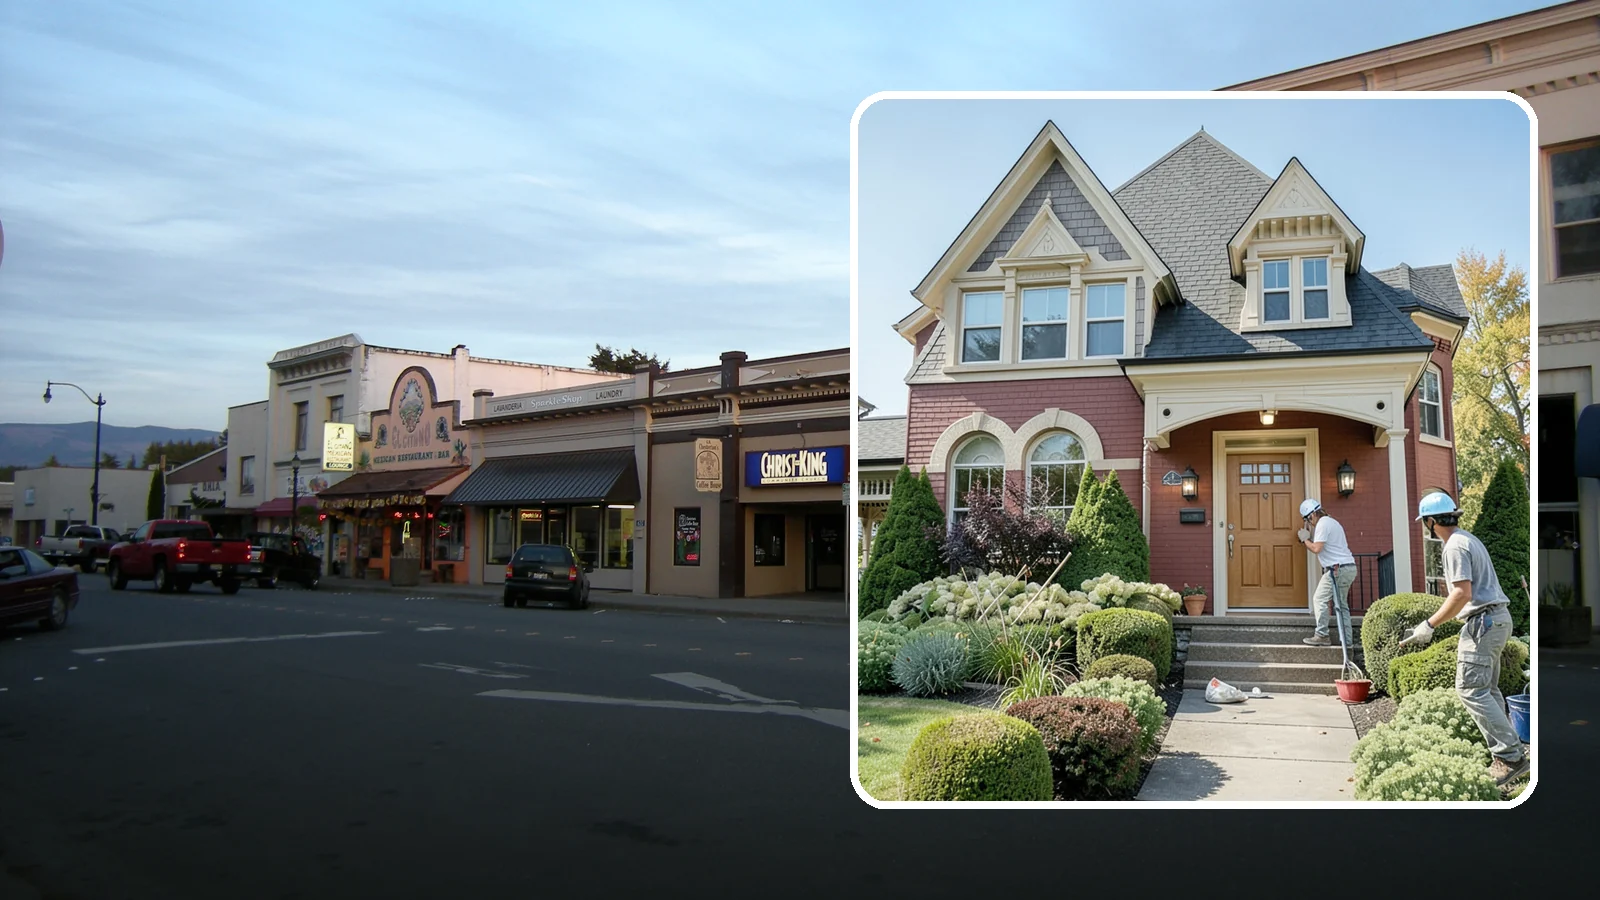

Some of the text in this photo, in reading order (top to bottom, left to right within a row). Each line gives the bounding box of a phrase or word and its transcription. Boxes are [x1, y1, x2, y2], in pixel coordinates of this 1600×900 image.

[493, 402, 522, 413] LAVANDERIA
[562, 394, 582, 404] Shop
[595, 389, 623, 400] LAUNDRY
[374, 455, 396, 464] MEXICAN
[397, 451, 433, 462] RESTAURANT
[438, 450, 450, 459] BAR
